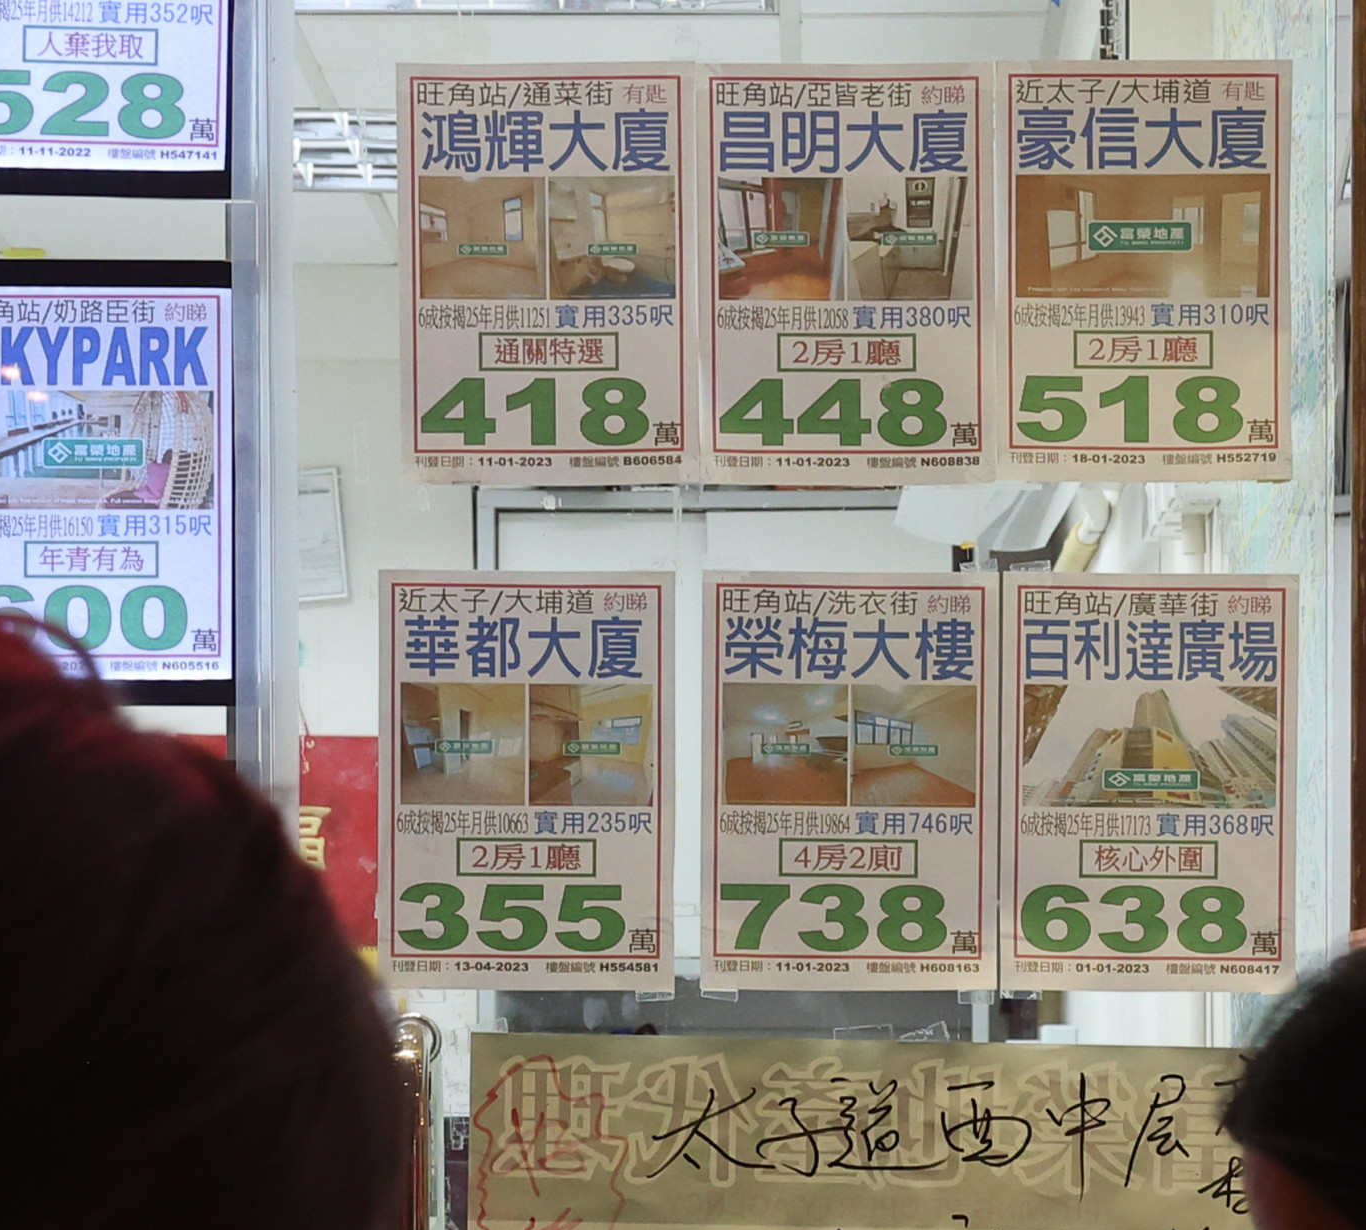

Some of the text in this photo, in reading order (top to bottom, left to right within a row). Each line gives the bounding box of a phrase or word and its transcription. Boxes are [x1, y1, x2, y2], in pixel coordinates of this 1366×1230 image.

[37, 30, 142, 59] 人棄我取
[417, 82, 612, 108] 旺角站/通菜街
[1016, 81, 1211, 104] 近太子/大埔道
[422, 109, 670, 172] 鴻輝大廈
[720, 111, 968, 173] 昌明大廈
[1017, 109, 1267, 171] 豪信大廈
[495, 338, 604, 364] 通關特選
[97, 514, 212, 537] 實用315呎
[39, 546, 144, 571] 年青有為
[722, 588, 918, 616] 旺角站/洗衣街
[1024, 591, 1217, 617] 旺角站/廣華街
[404, 616, 643, 679] 華都大廈
[724, 616, 975, 681] 榮梅大樓
[1024, 619, 1277, 681] 百利達廣場
[1095, 845, 1203, 872] 核心外圍
